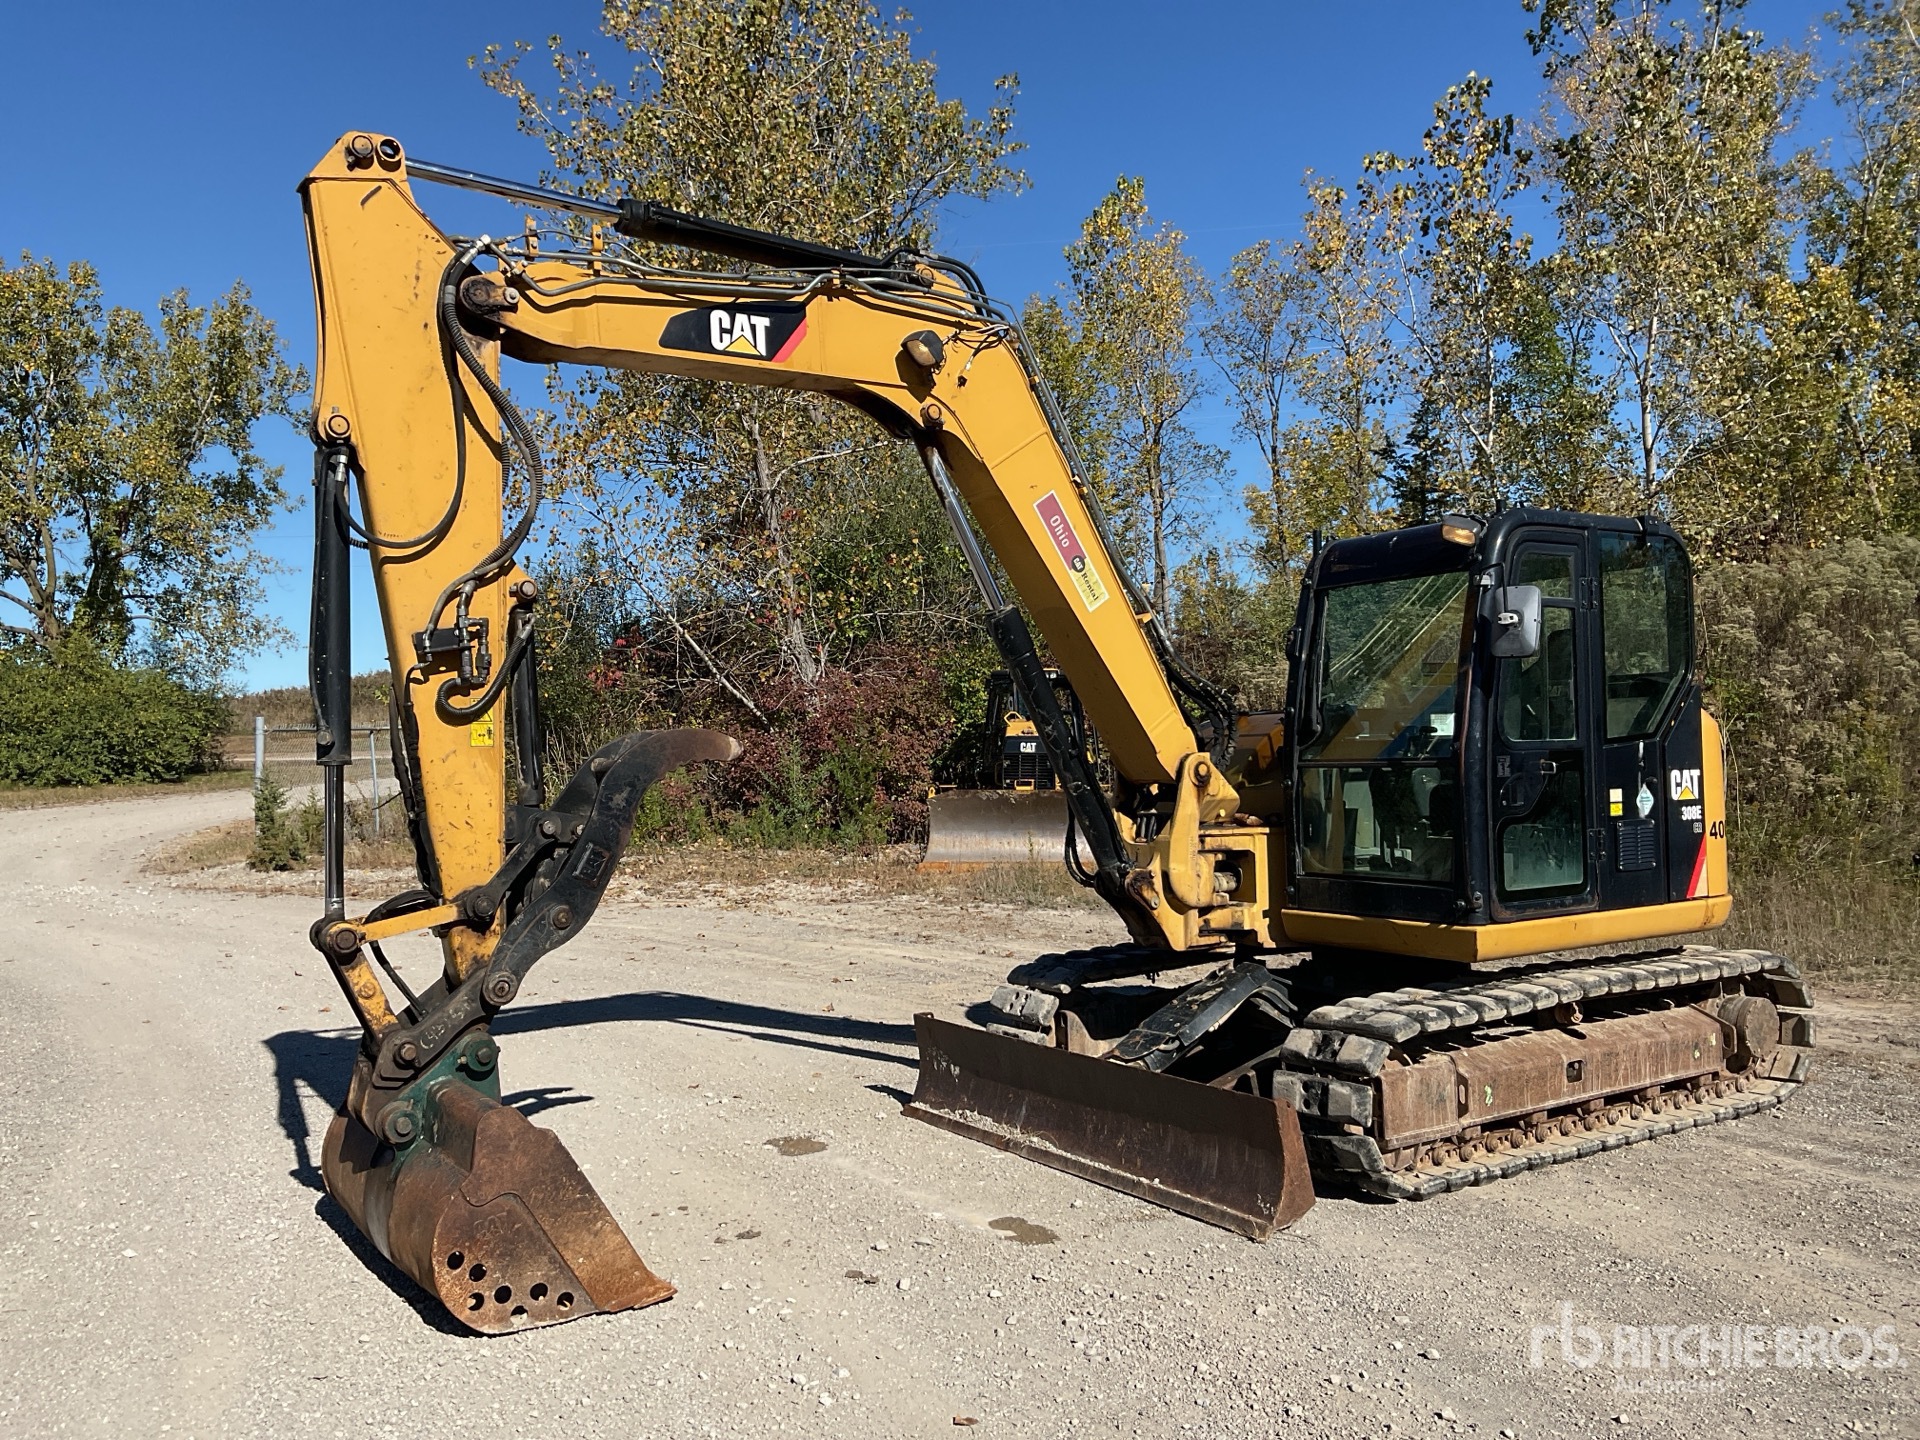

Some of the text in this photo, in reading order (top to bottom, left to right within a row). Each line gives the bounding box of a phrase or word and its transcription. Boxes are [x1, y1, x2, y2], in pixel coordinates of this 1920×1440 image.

[709, 309, 771, 357] CAT
[1050, 515, 1099, 601] Ohio CAT Rental
[1020, 742, 1037, 753] CAT
[1670, 769, 1701, 801] CAT
[1681, 806, 1702, 820] 308E
[1709, 820, 1725, 840] 40
